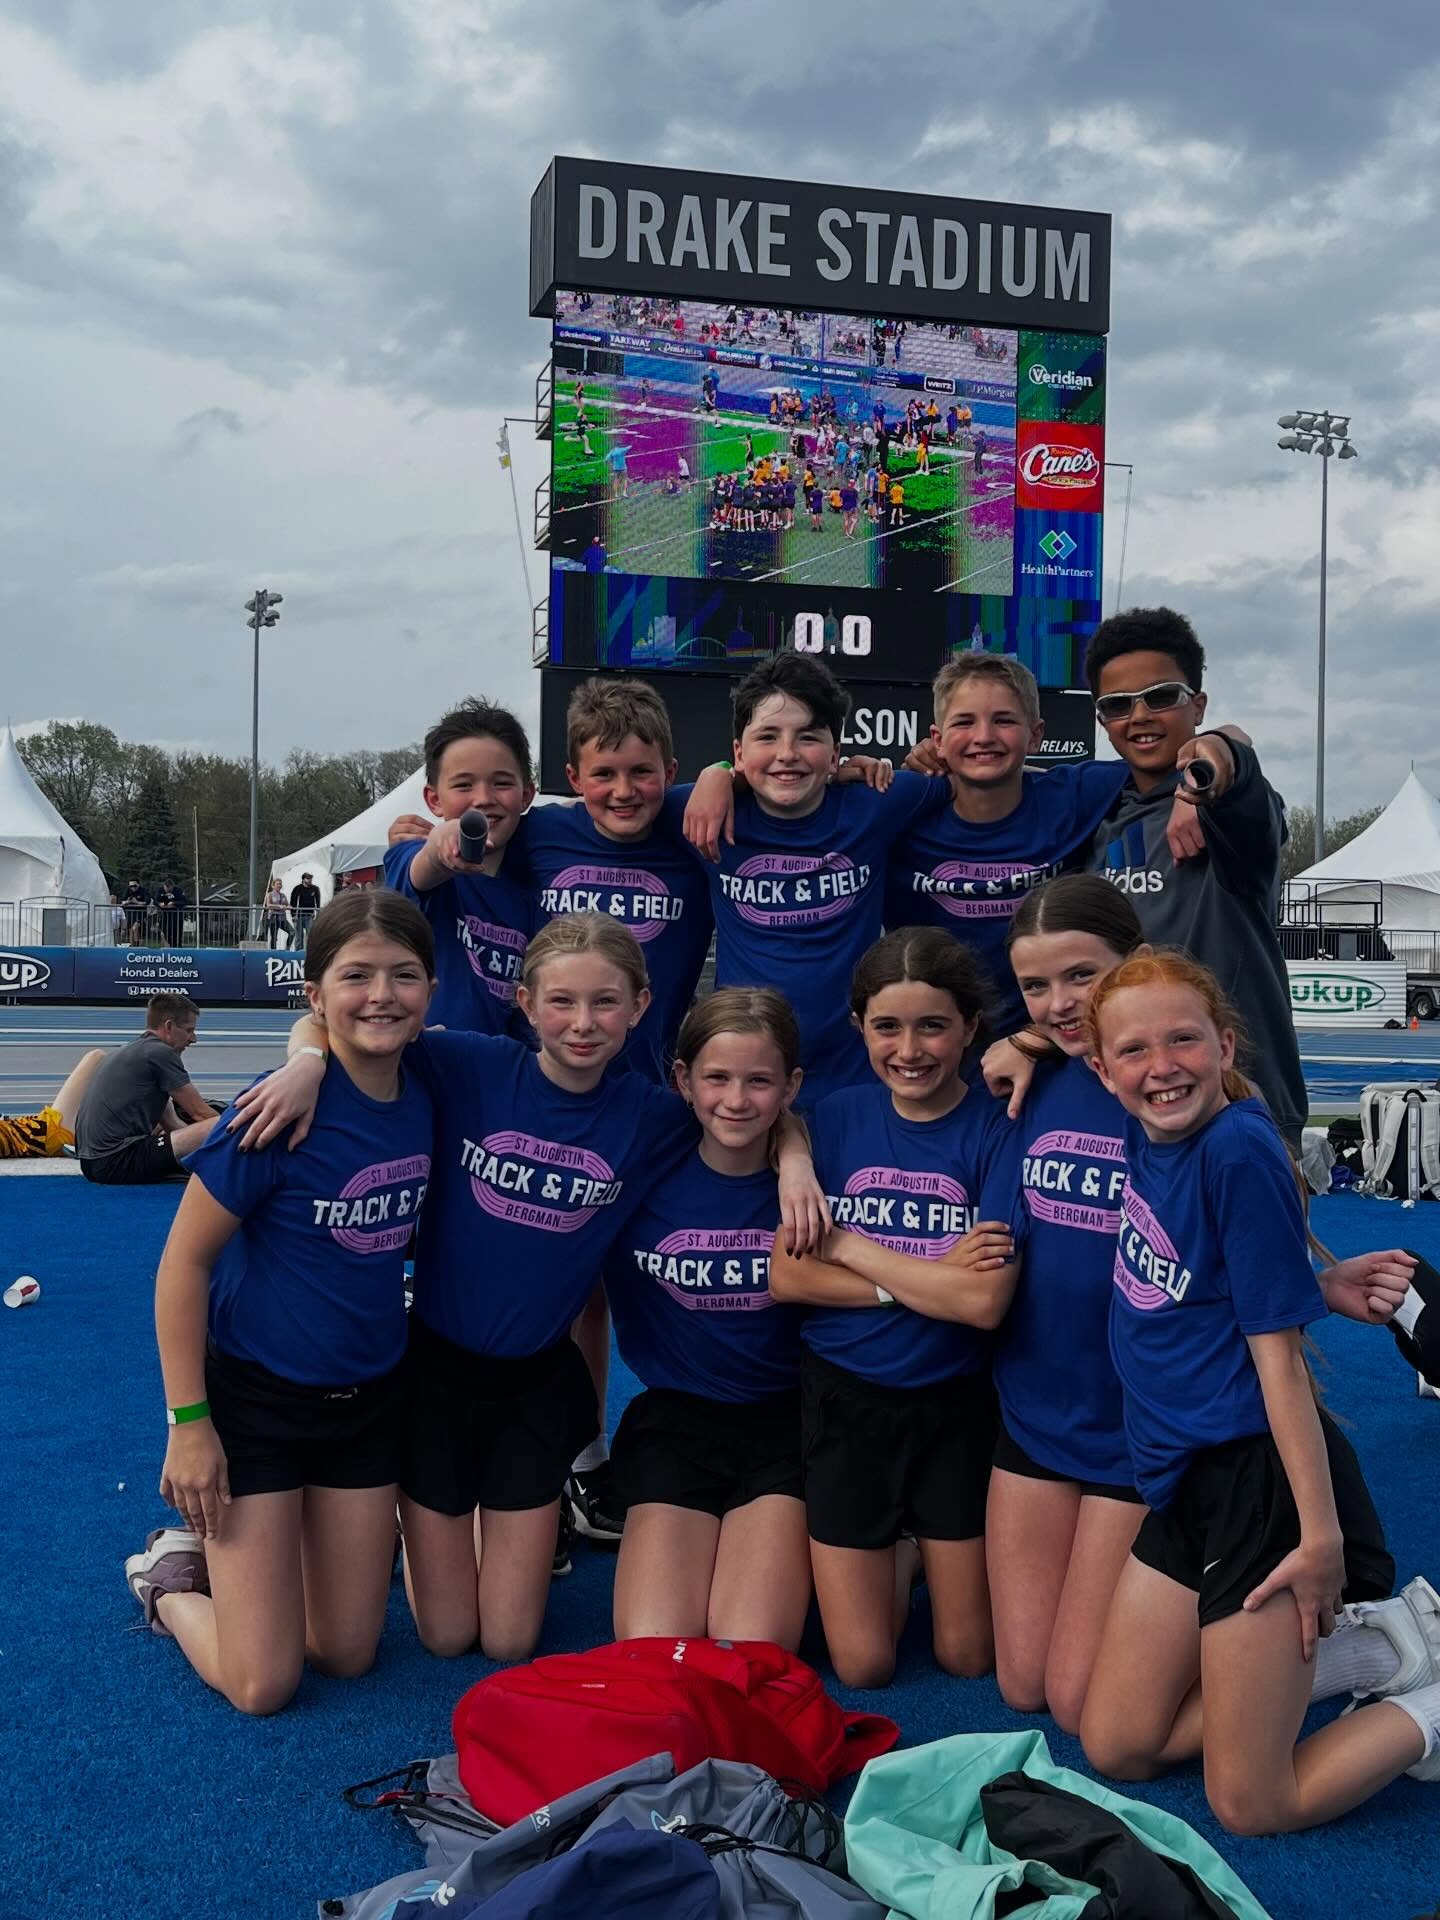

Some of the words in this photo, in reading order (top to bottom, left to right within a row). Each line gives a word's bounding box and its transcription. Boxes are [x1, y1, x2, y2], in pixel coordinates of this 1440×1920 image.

[578, 183, 791, 277] DRAKE
[816, 207, 1091, 303] STADIUM
[1028, 364, 1093, 387] Veridian
[1023, 443, 1097, 482] Cane's
[1021, 563, 1094, 578] HealthPartners
[794, 611, 872, 656] 0.0
[1040, 740, 1085, 754] RELAYS
[597, 871, 643, 884] AUGUSTIN
[719, 873, 786, 904] TRACK
[795, 878, 811, 902] &
[819, 864, 871, 899] FIELD
[985, 878, 1002, 895] &
[540, 889, 602, 913] TRACK
[609, 893, 626, 917] &
[633, 894, 684, 921] FIELD
[965, 903, 1013, 915] BERGMAN
[769, 911, 820, 926] BERGMAN
[126, 952, 165, 964] Central
[167, 952, 192, 964] Iowa
[488, 950, 503, 974] &
[120, 967, 156, 978] Honda
[159, 966, 199, 979] Dealers
[140, 986, 189, 995] HONDA
[1291, 980, 1373, 1010] ukup
[514, 1136, 530, 1150] ST.
[533, 1142, 585, 1166] AUGUSTIN
[1056, 1134, 1071, 1149] ST.
[460, 1138, 536, 1194] TRACK
[541, 1173, 562, 1200] &
[568, 1177, 623, 1207] FIELD
[870, 1171, 886, 1185] ST.
[890, 1173, 940, 1191] AUGUSTIN
[1081, 1167, 1101, 1197] &
[313, 1193, 392, 1227] TRACK
[396, 1189, 411, 1217] &
[505, 1203, 561, 1228] BERGMAN
[824, 1195, 897, 1227] TRACK
[902, 1200, 921, 1230] &
[1053, 1205, 1104, 1227] BERGMAN
[688, 1233, 703, 1247] ST.
[707, 1233, 761, 1248] AUGUSTIN
[633, 1250, 714, 1287] TRACK
[723, 1260, 743, 1286] &
[1126, 1231, 1140, 1264] &
[1138, 1244, 1192, 1303] FIELD
[696, 1296, 750, 1308] BERGMAN
